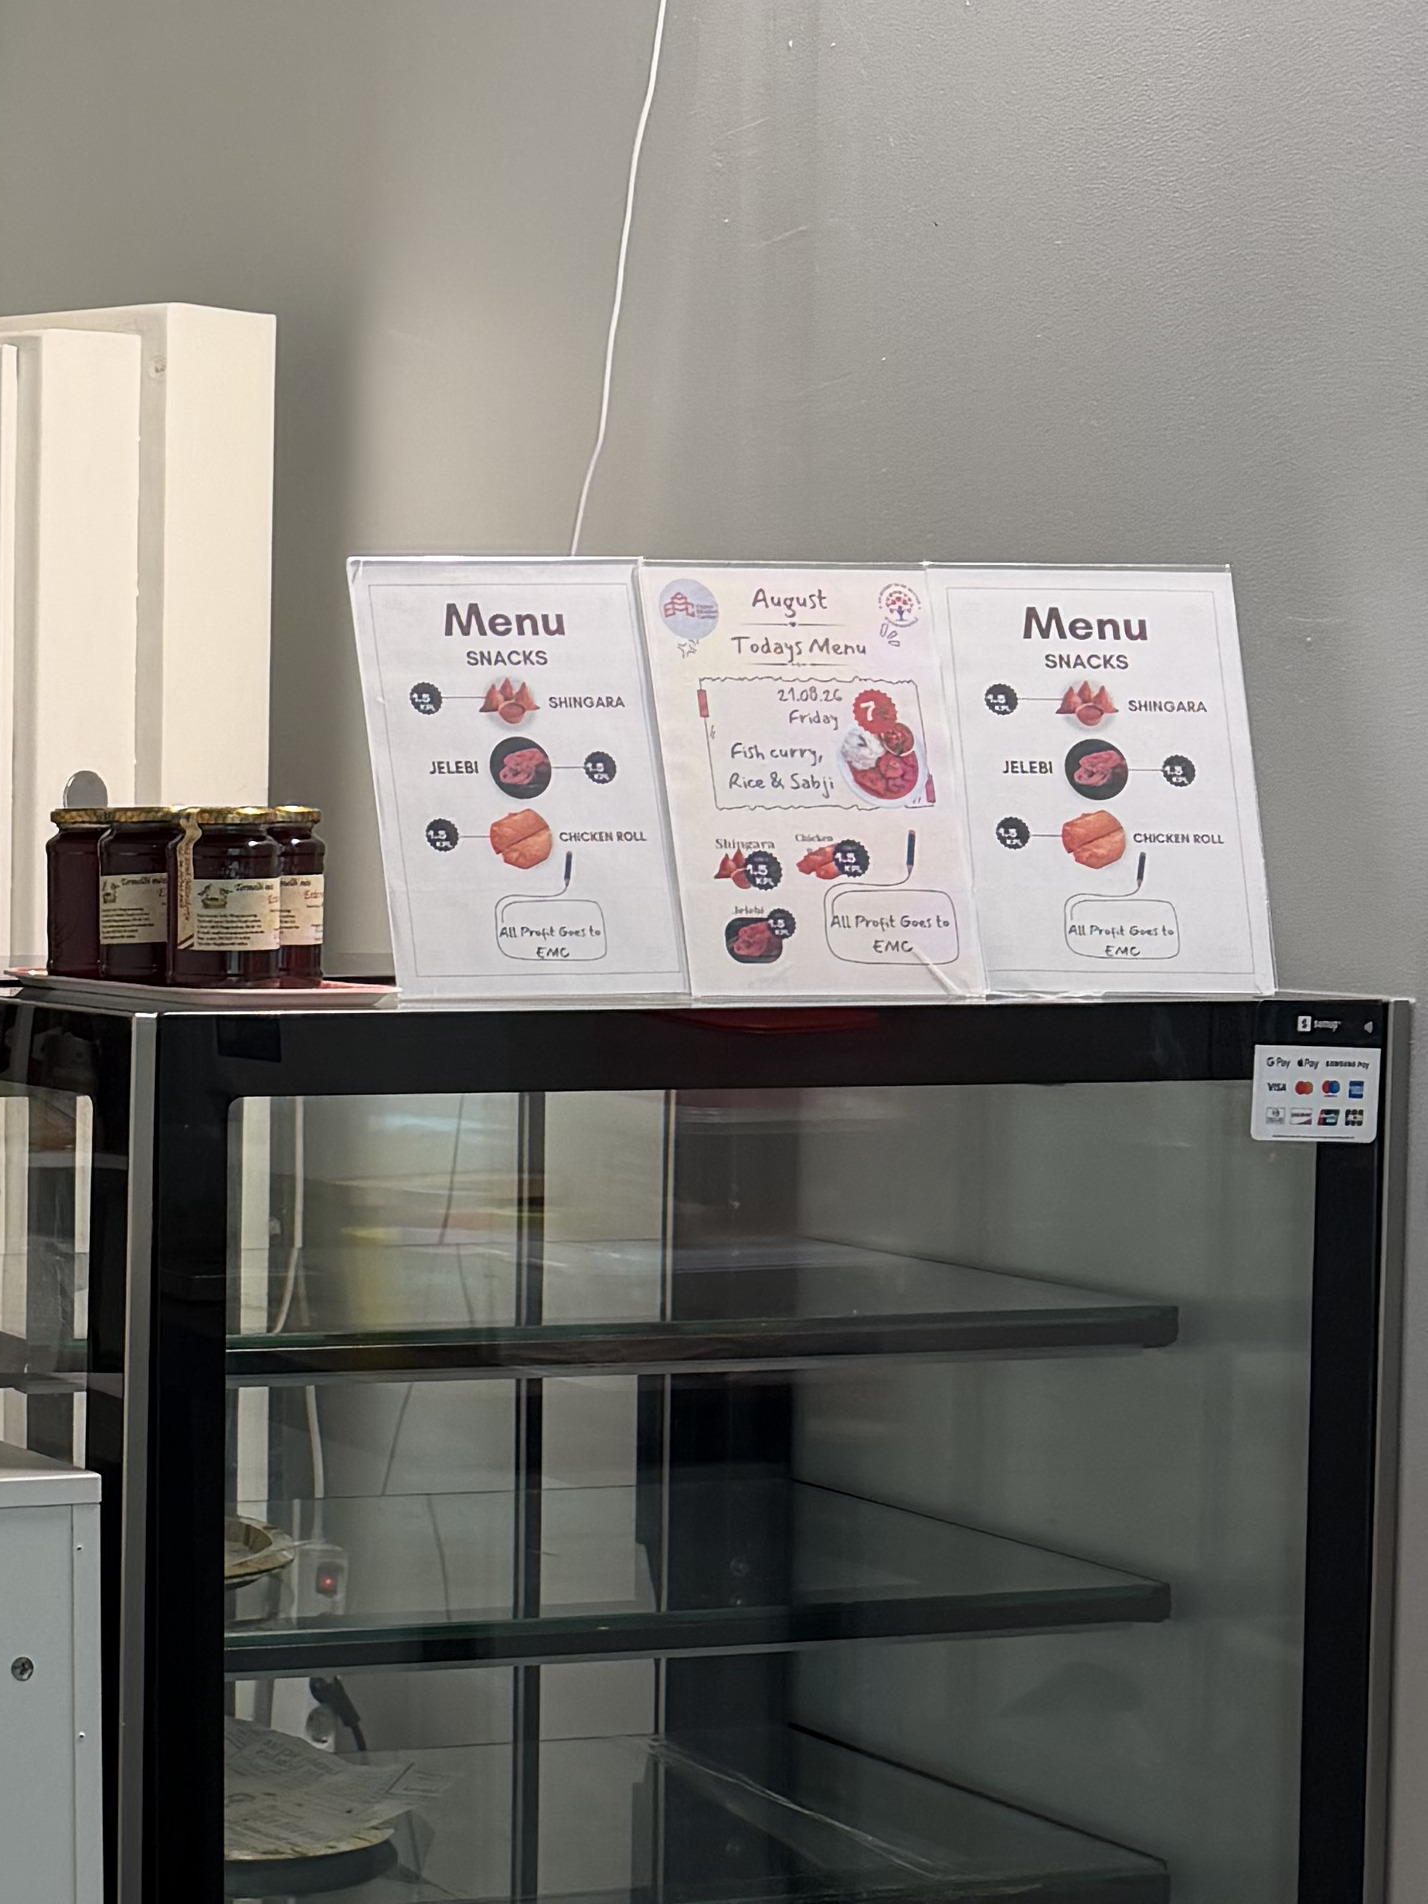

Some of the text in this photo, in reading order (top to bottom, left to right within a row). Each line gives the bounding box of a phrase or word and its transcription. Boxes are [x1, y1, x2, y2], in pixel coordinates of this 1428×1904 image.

[752, 588, 828, 617] August
[444, 603, 566, 636] Menu
[1023, 607, 1148, 641] Menu
[731, 637, 866, 663] Todays Menu
[466, 650, 548, 666] SNACKS
[1044, 654, 1129, 670] SNACKS
[777, 687, 843, 702] 21.08.26
[548, 696, 626, 709] SHINGARA
[1128, 699, 1207, 713] SHINGARA
[789, 710, 839, 730] Friday
[730, 743, 823, 767] Fish curry,
[429, 761, 479, 774] JELEBI
[1003, 761, 1053, 774] JELEBI
[729, 772, 834, 798] Rice & Sabji
[559, 831, 647, 843] CHICKEN ROLL
[795, 833, 834, 843] Chicken
[1133, 833, 1224, 844] CHICKEN ROLL
[715, 838, 775, 853] Shingara
[834, 852, 856, 863] 1.5
[746, 863, 768, 875] 1.5
[830, 915, 950, 931] All Profit Goes to
[499, 925, 601, 940] All Profit Goes to
[1068, 924, 1174, 937] All Profit Goes to
[536, 946, 570, 958] EMC
[873, 939, 913, 953] EMC
[1105, 945, 1141, 957] EMC
[1267, 1083, 1287, 1092] VISA
